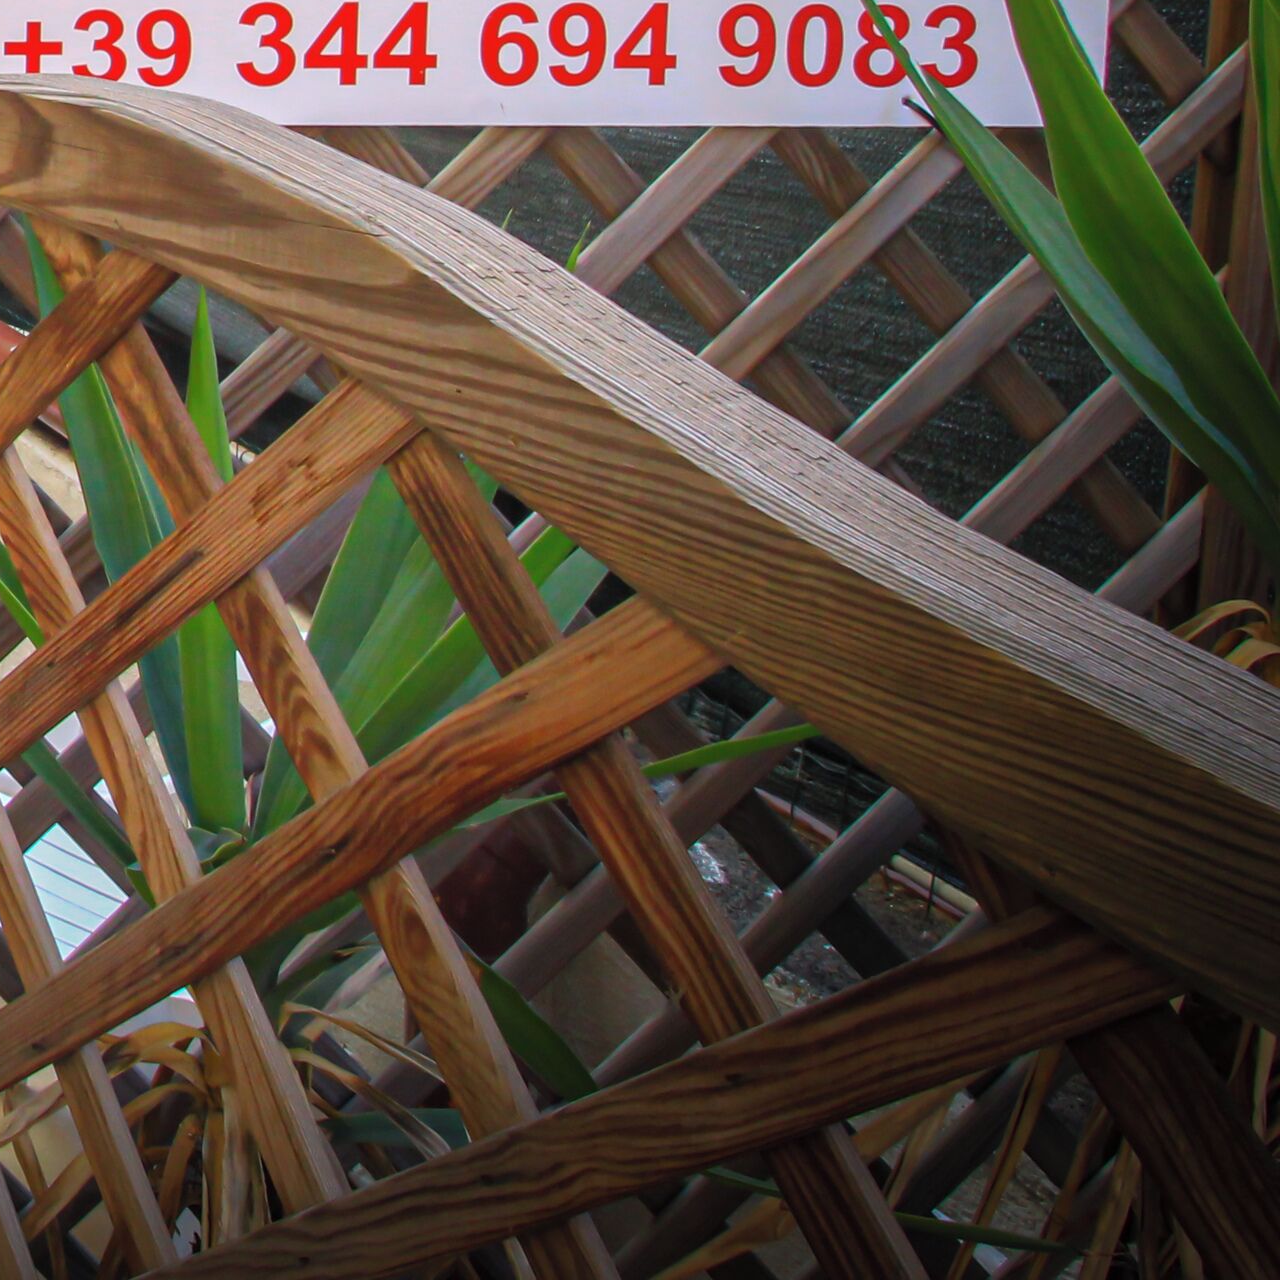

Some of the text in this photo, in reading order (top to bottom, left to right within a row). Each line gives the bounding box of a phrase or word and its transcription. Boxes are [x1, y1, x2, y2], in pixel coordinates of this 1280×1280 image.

[3, 0, 979, 88] +39 344 694 9083
